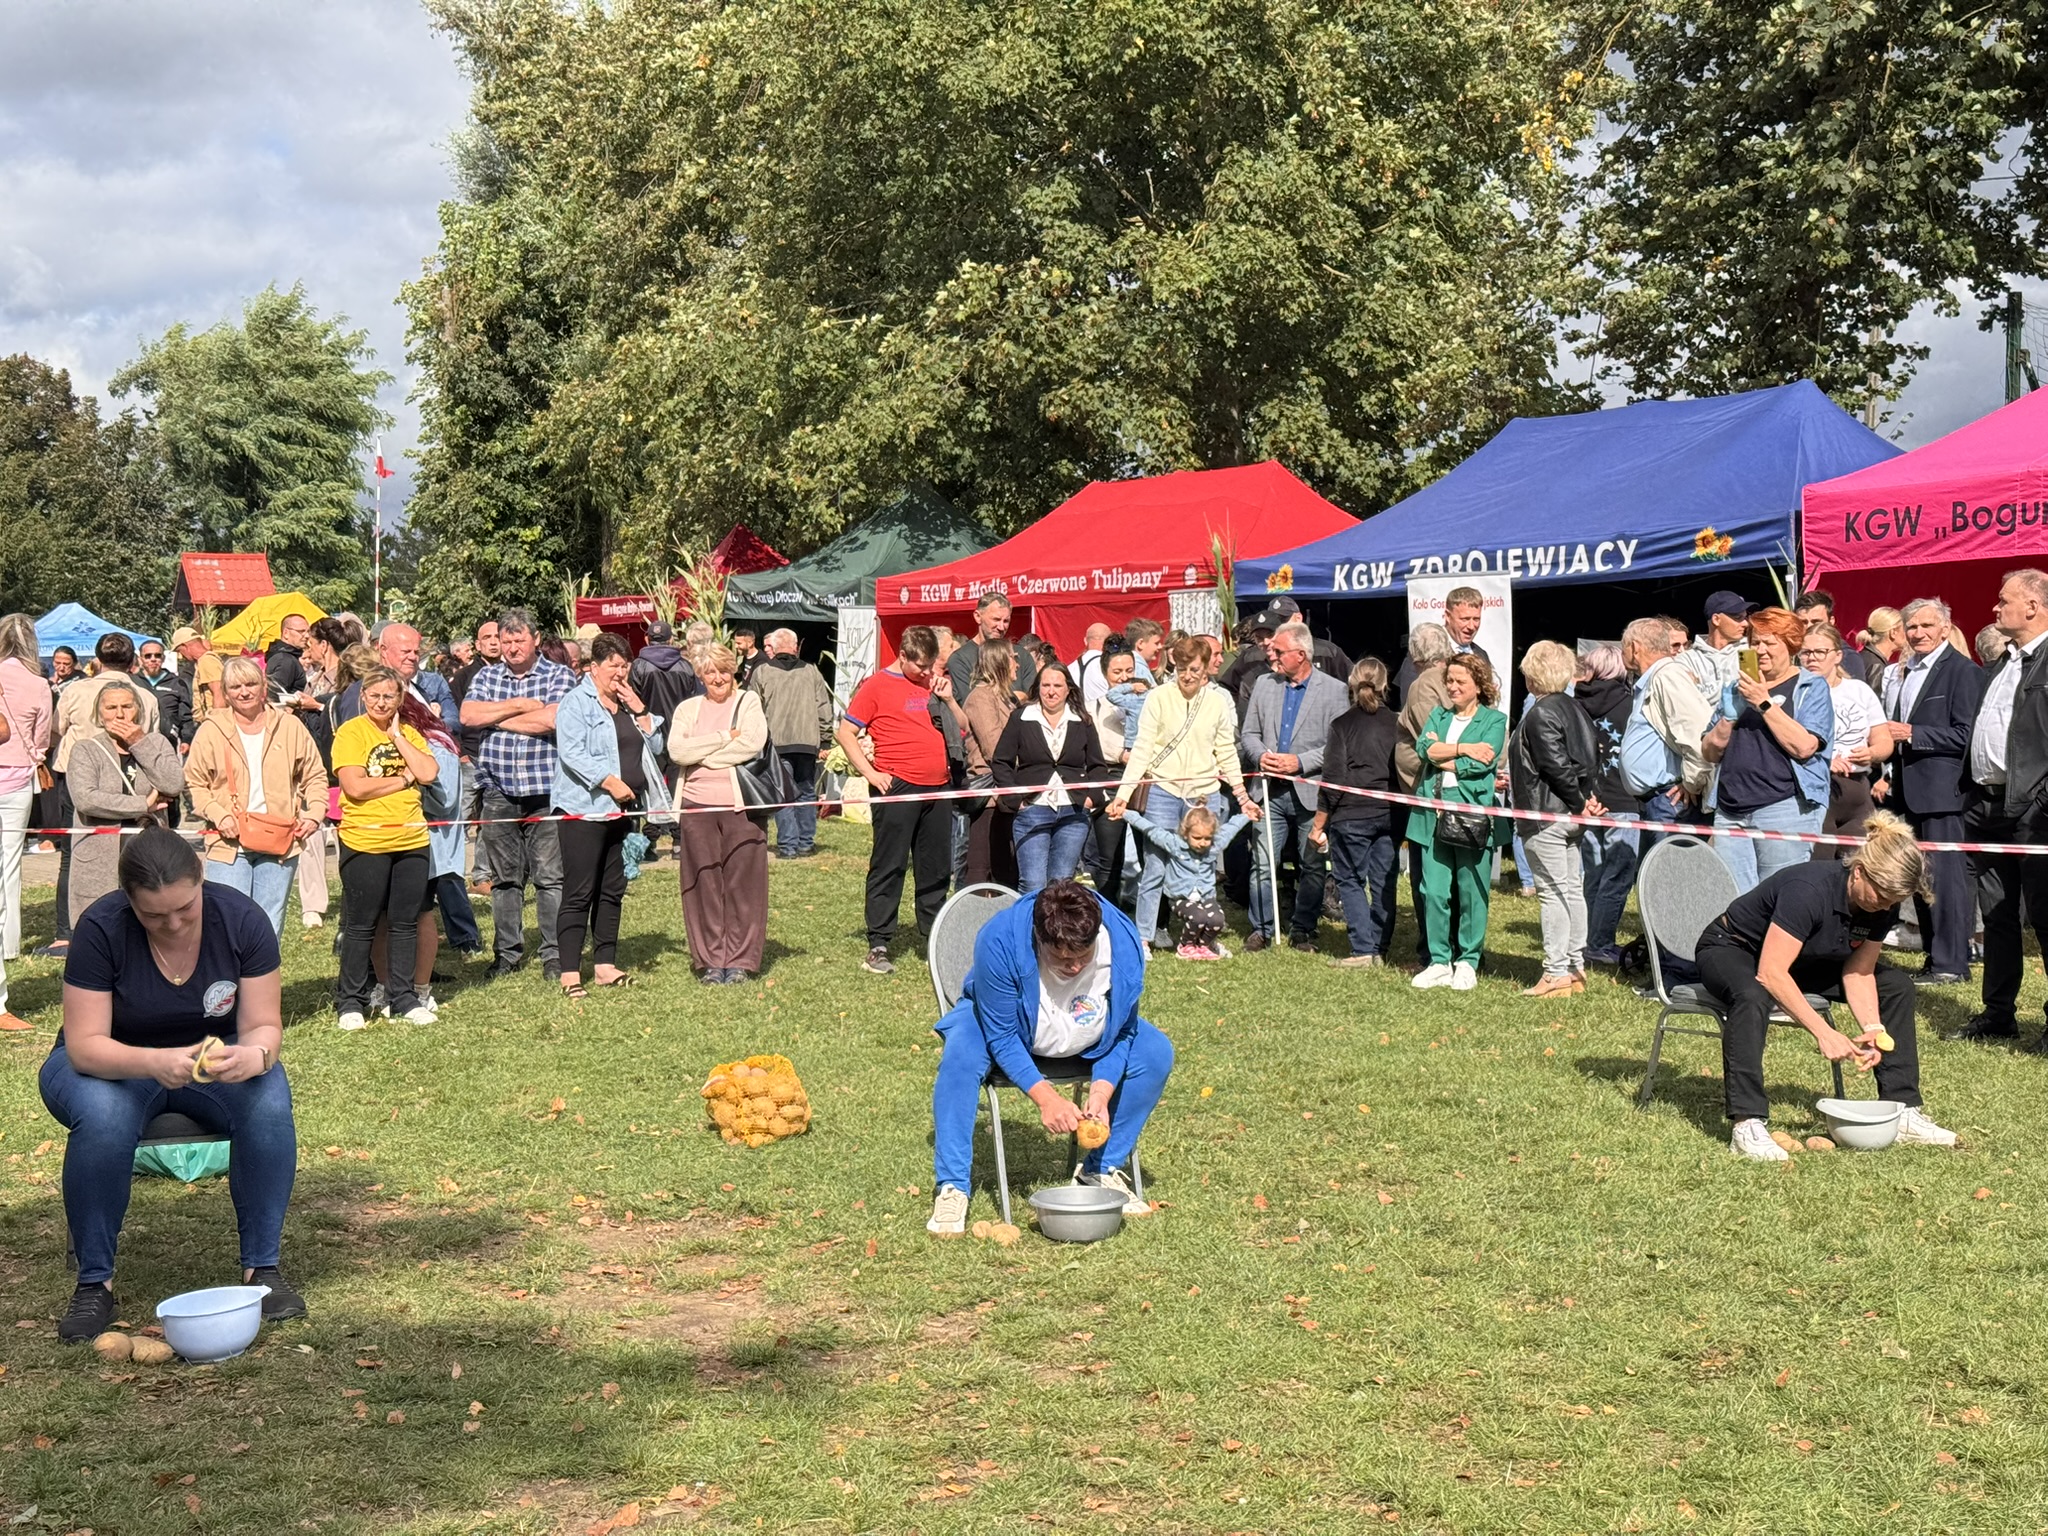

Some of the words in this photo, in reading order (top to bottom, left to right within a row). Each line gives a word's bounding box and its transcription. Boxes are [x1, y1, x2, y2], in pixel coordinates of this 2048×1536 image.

[1844, 504, 1923, 543] KGW
[920, 583, 952, 602] KGW
[954, 587, 965, 601] w
[1012, 574, 1087, 595] "Czerwone
[1092, 565, 1169, 593] Tulipany"
[1333, 561, 1395, 592] KGW
